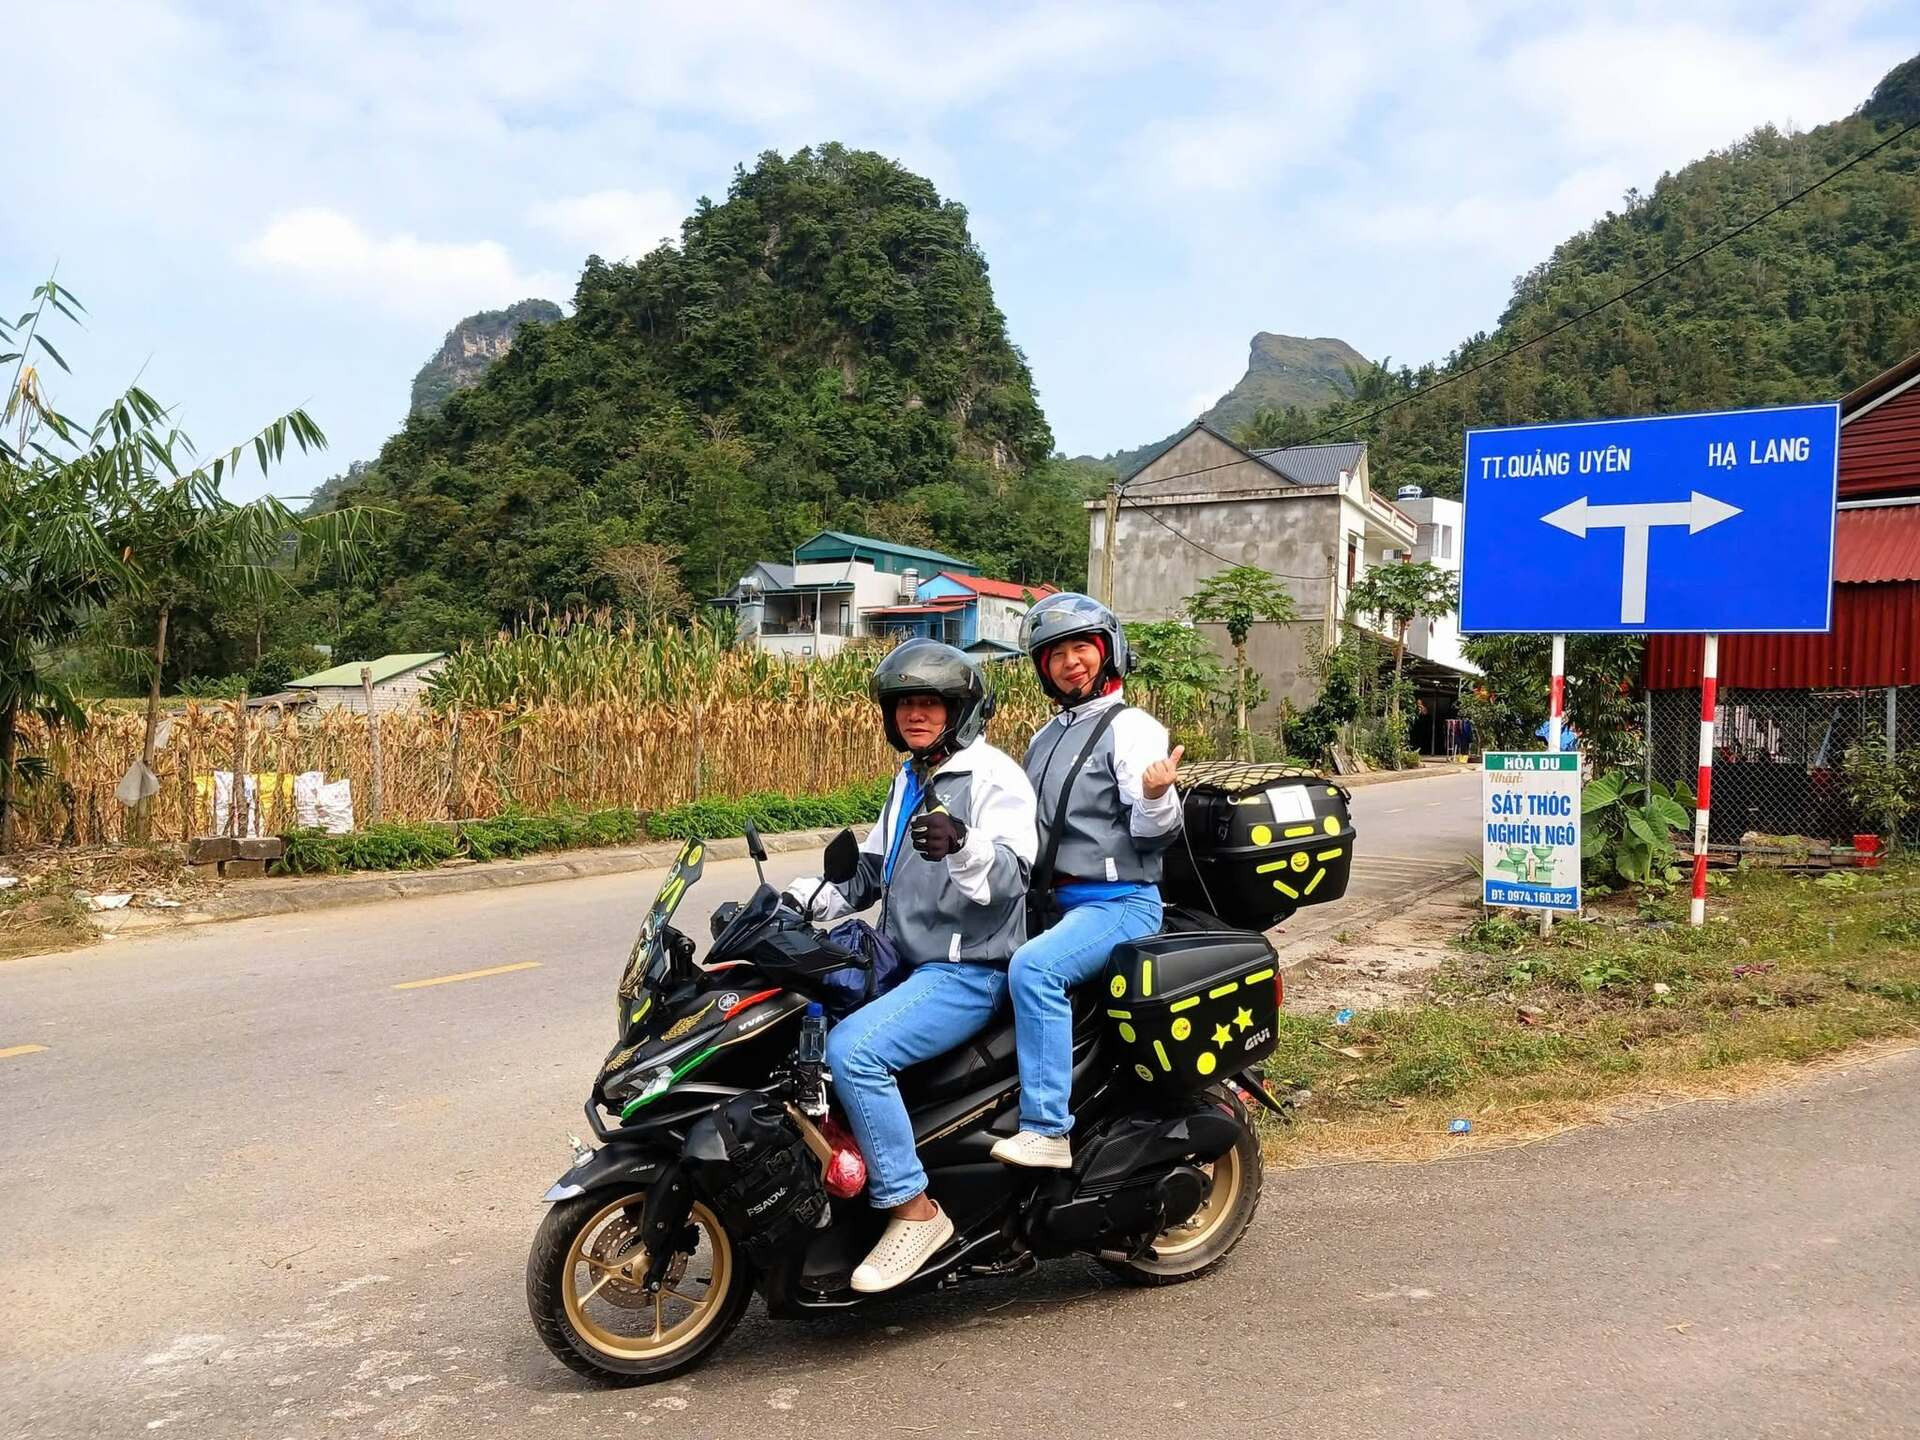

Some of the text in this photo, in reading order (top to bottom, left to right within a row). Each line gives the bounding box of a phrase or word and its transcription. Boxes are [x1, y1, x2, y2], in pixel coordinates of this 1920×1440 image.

[1481, 444, 1631, 479] TT.QUẢNG UYÊN
[1708, 437, 1810, 470] HẠ LANG
[1540, 757, 1560, 770] DU
[1491, 790, 1571, 816] SÁT THÓC
[1545, 822, 1575, 846] NGÔ
[1507, 890, 1572, 905] 0974.160.822
